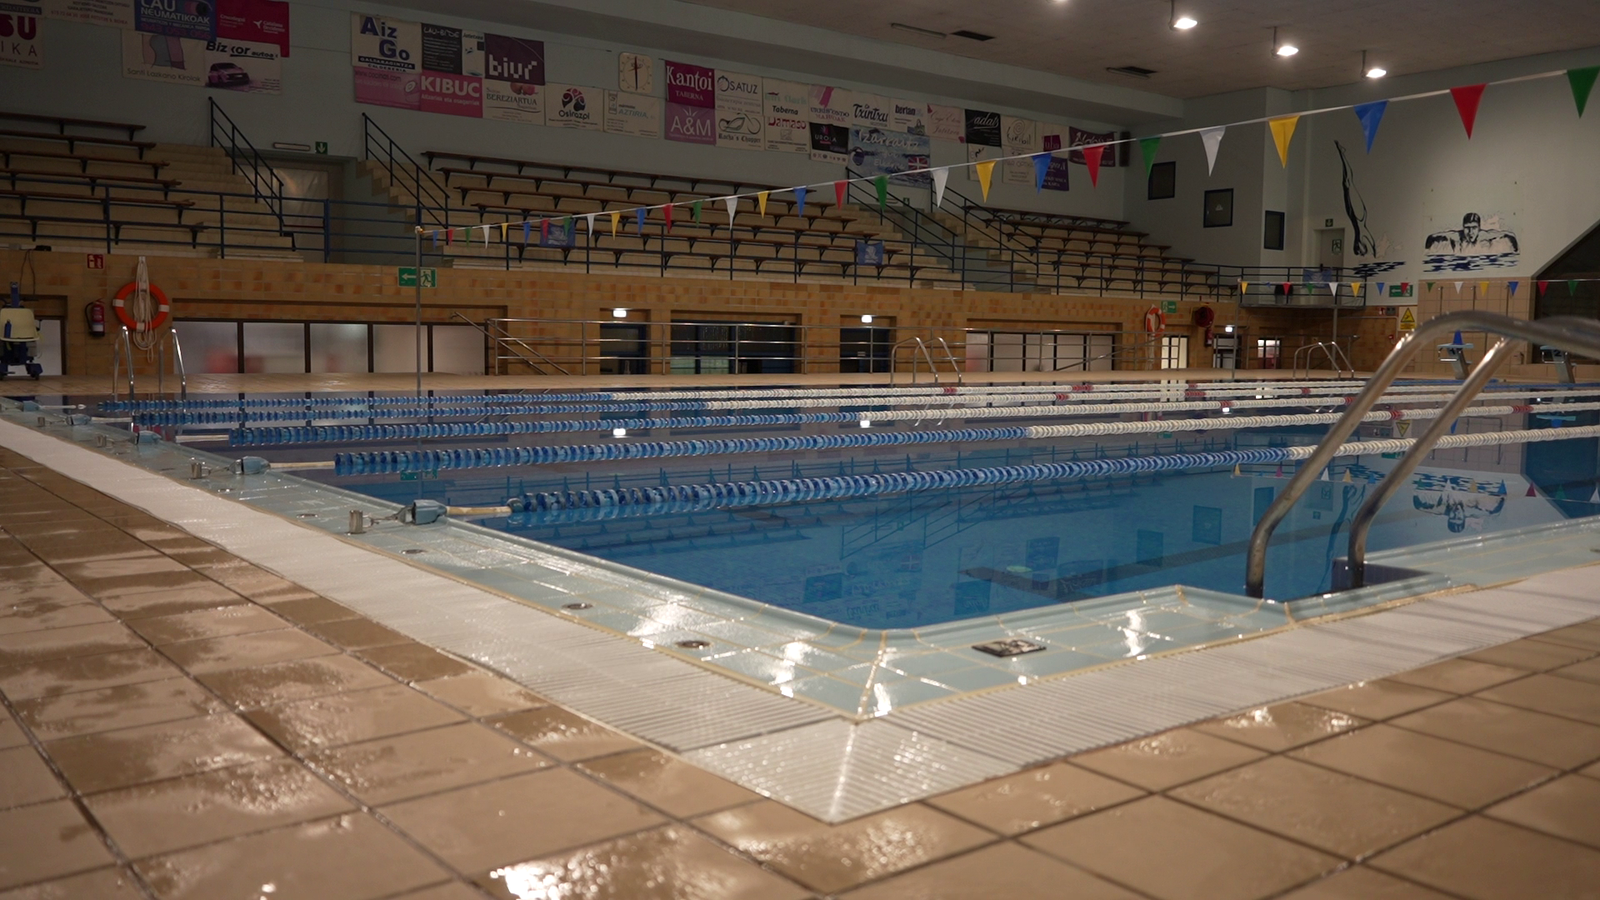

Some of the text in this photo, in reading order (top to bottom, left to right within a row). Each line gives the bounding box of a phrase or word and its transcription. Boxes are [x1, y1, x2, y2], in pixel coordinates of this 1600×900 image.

[140, 7, 210, 24] NEUMATIKOAK
[360, 16, 398, 39] Aiz
[205, 41, 228, 54] Biz
[379, 39, 410, 61] Go
[127, 67, 146, 76] Santi
[666, 65, 713, 91] Kantoi
[420, 75, 480, 97] KIBUC
[675, 90, 704, 101] TABERNA
[486, 93, 538, 106] BEREZIARTUA
[670, 115, 711, 137] A&M
